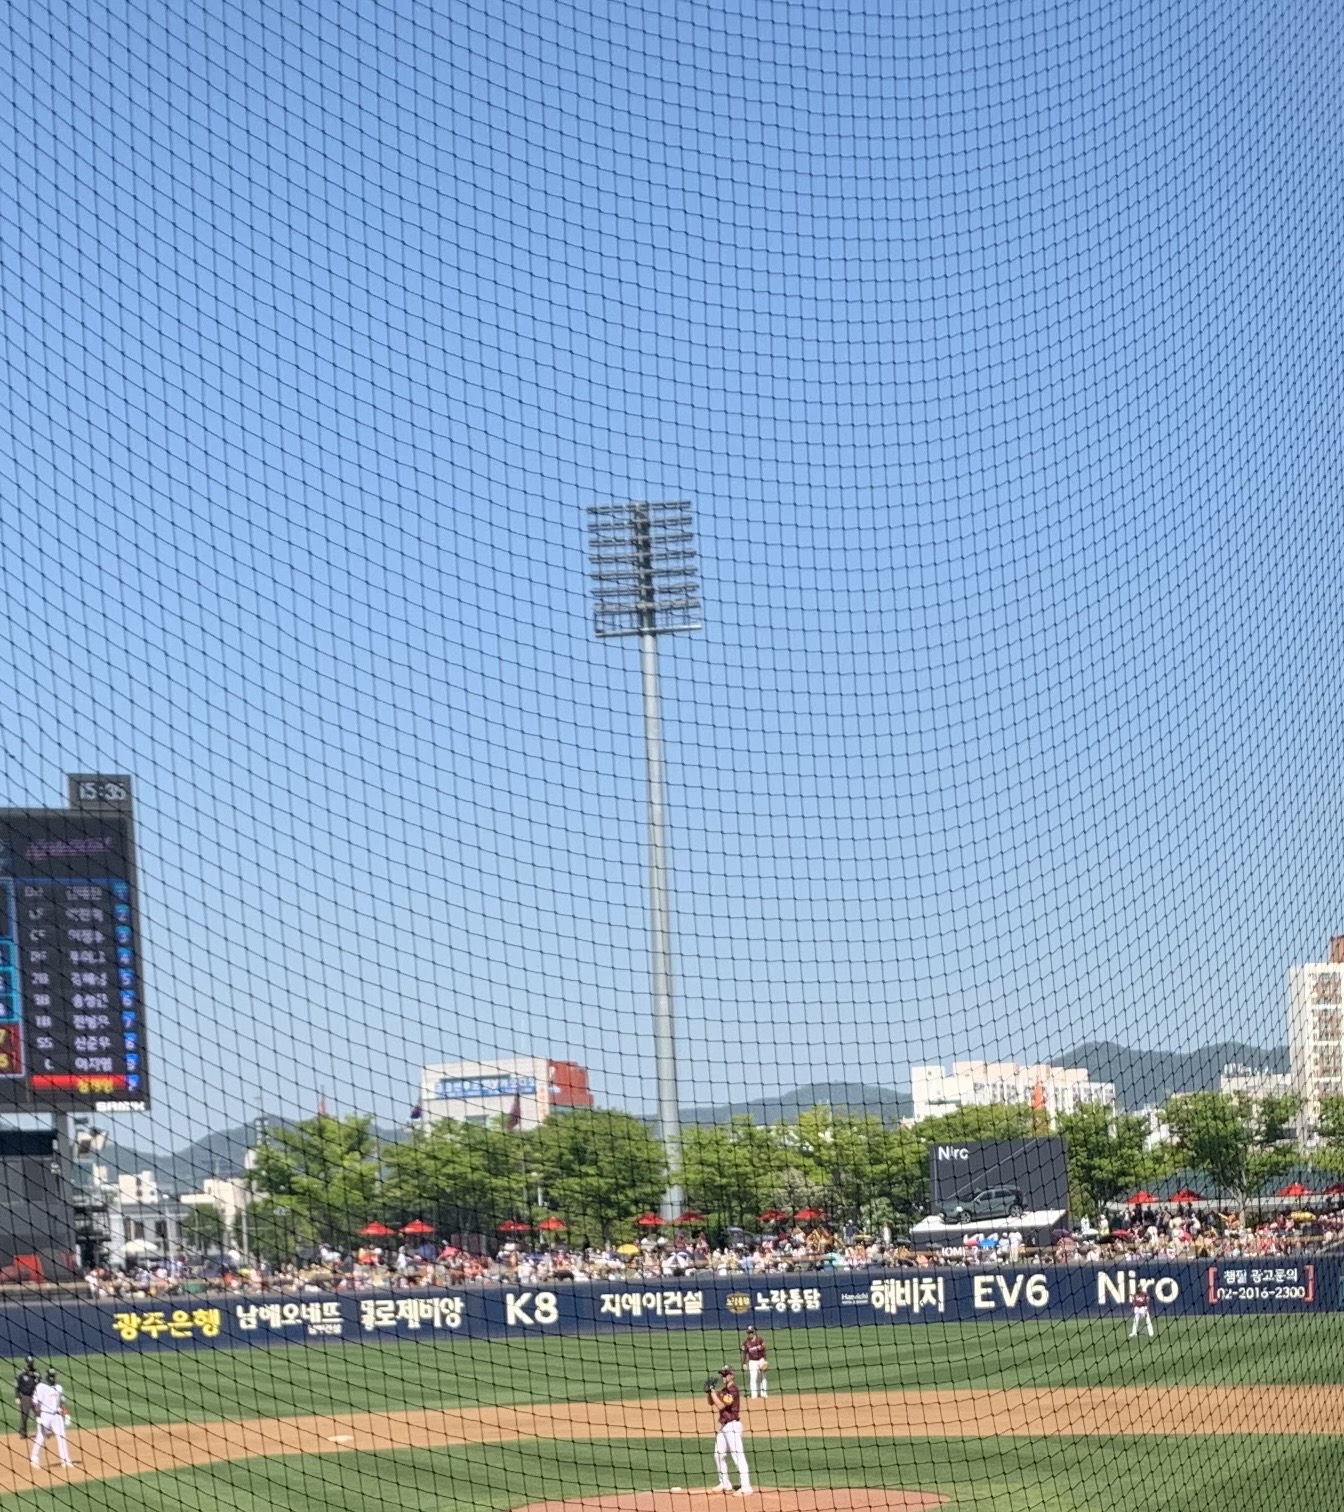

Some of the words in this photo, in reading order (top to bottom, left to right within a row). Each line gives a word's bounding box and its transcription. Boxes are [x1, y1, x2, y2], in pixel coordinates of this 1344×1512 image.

[600, 1291, 703, 1316] 지에이건설
[754, 1288, 821, 1312] 노랑통닭
[870, 1277, 945, 1314] 해비치
[973, 1273, 1049, 1308] EV6
[1097, 1269, 1179, 1304] Niro
[112, 1307, 222, 1341] 광주은행
[505, 1292, 559, 1326] K8
